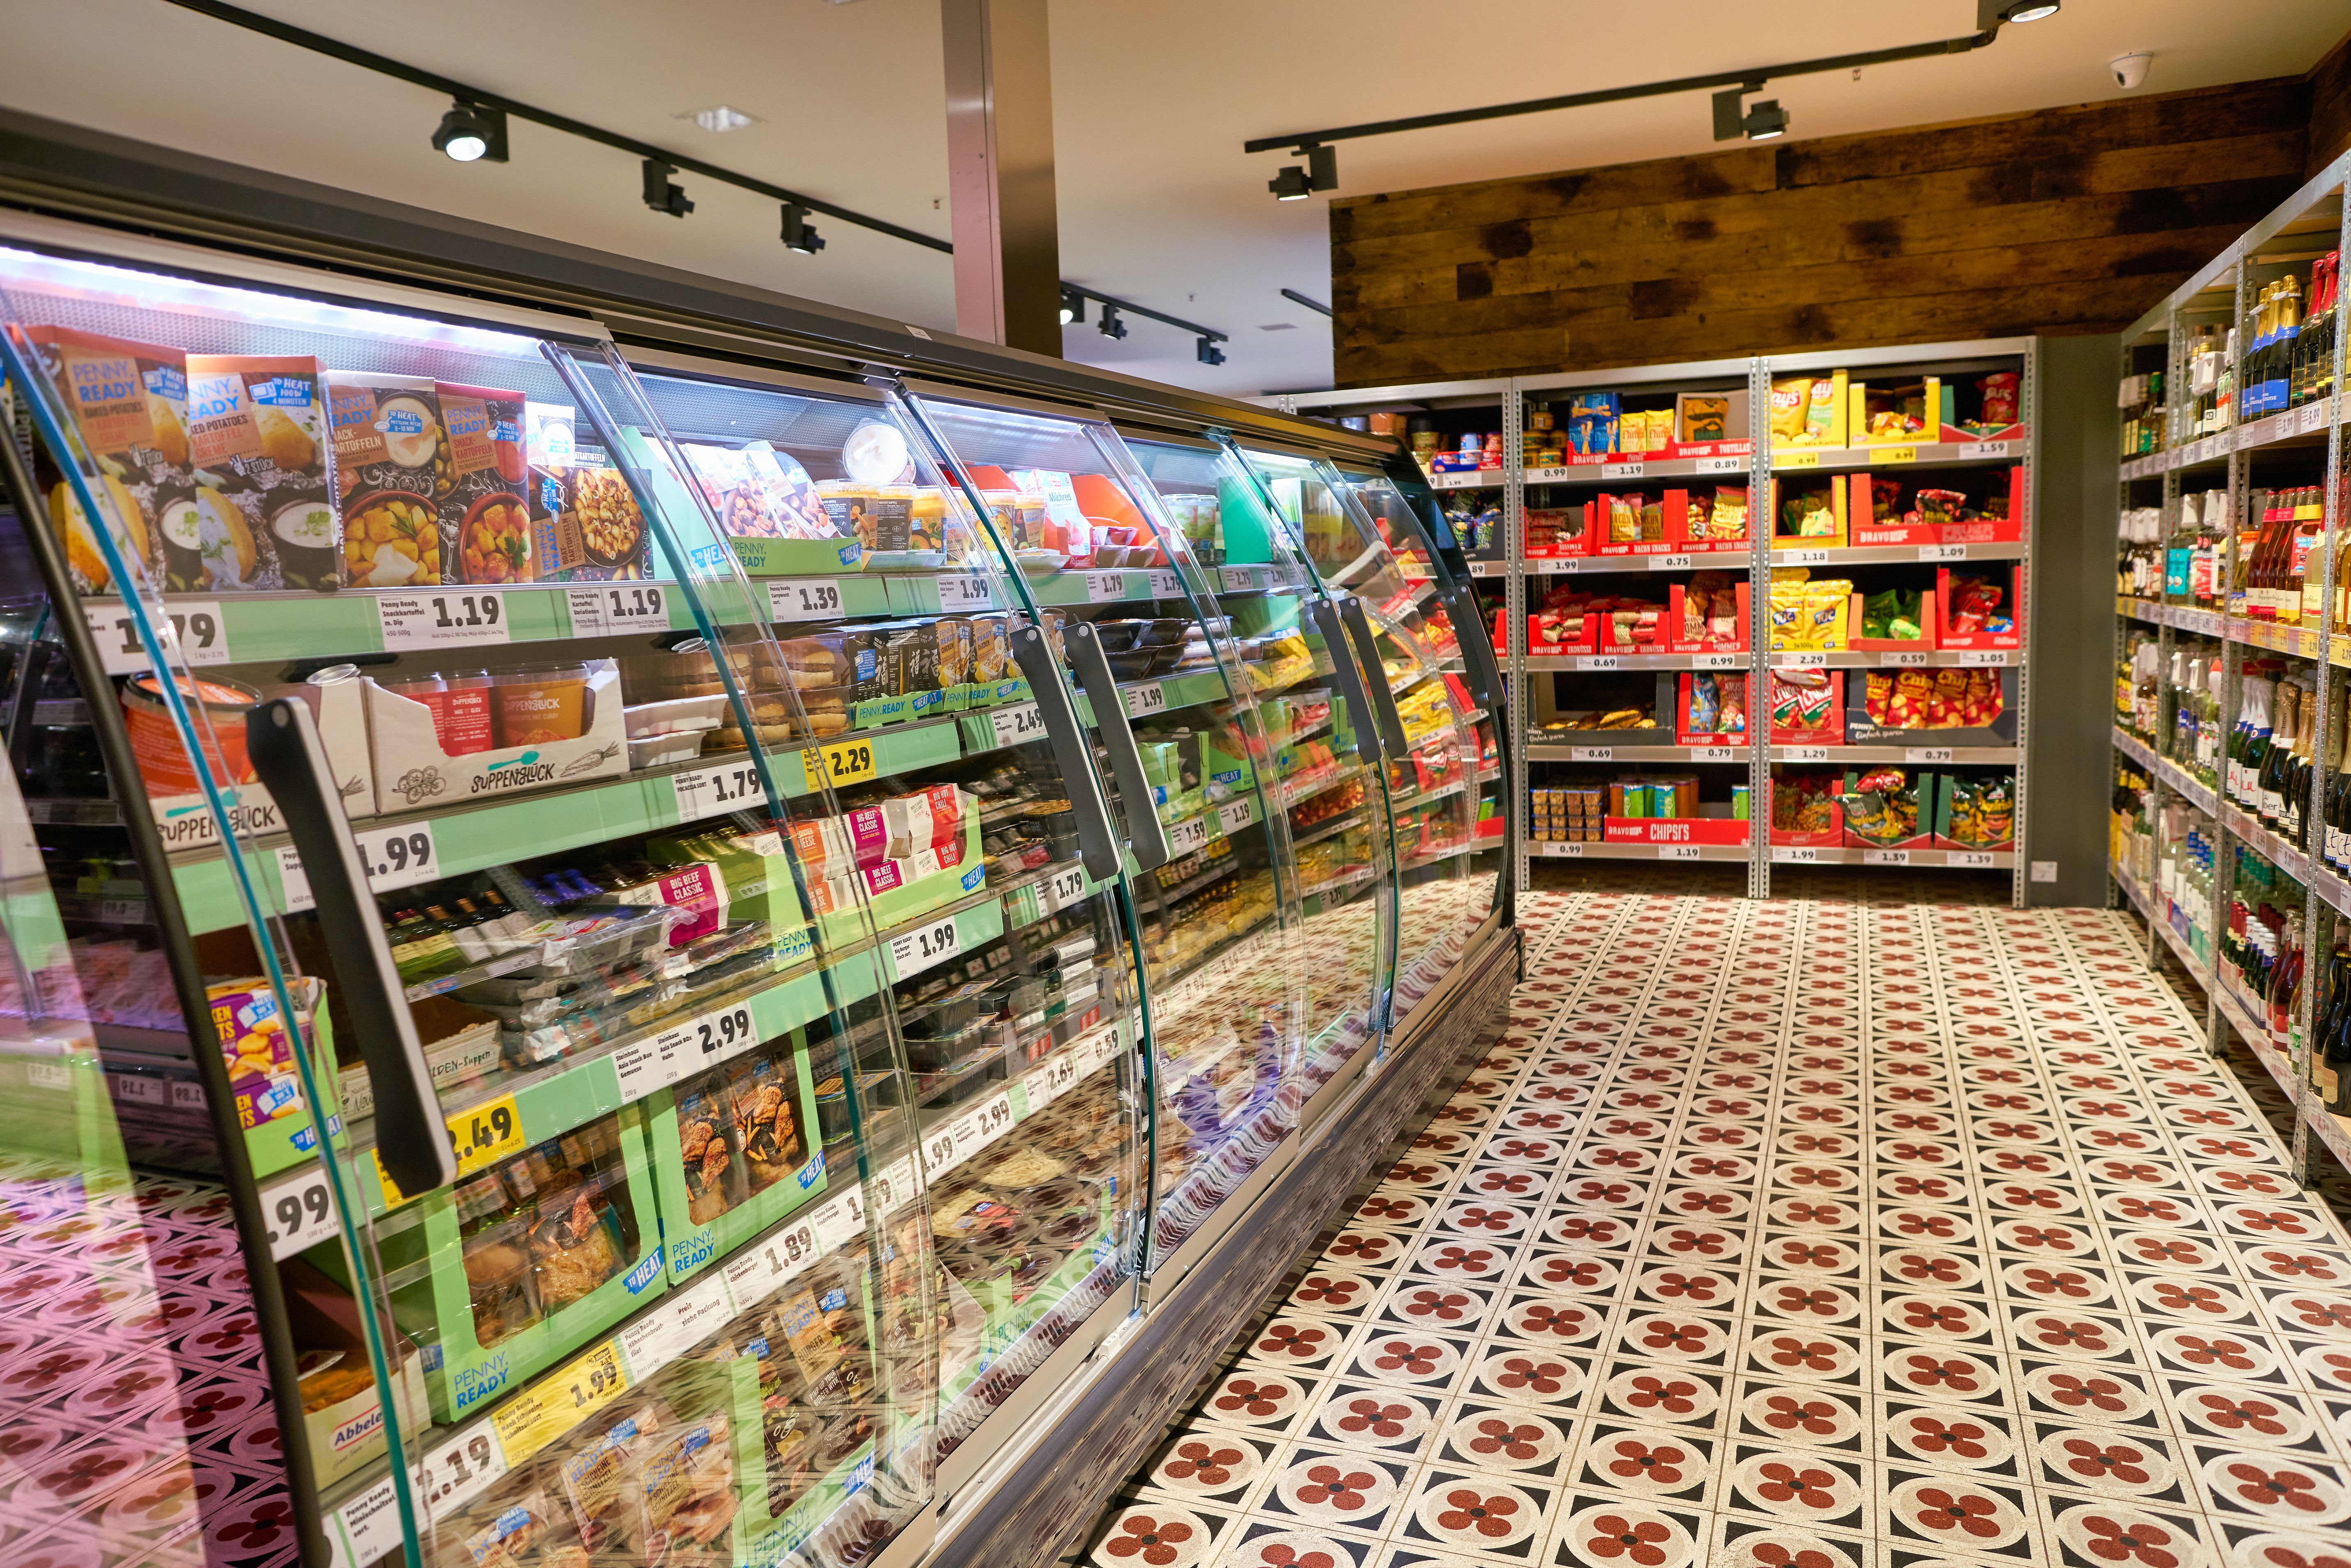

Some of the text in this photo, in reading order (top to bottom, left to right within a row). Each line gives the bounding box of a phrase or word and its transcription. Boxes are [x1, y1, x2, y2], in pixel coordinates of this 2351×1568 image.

[72, 360, 135, 382] PENNY.
[78, 381, 135, 403] READY
[283, 381, 311, 391] HEAT
[446, 405, 486, 422] PENNY.
[2309, 407, 2320, 425] 5.99
[450, 419, 486, 436] READY
[2283, 416, 2293, 432] 5.99
[453, 436, 476, 449] SNACK-
[1979, 443, 2004, 453] 1.59
[456, 444, 492, 459] KARTOFFELN
[1895, 451, 1914, 459] 0.99
[1715, 459, 1738, 469] 0.89
[1798, 456, 1816, 464] 0.99
[1544, 468, 1566, 478] 0.99
[1620, 465, 1642, 475] 1.19
[1049, 491, 1072, 502] Milchreis
[565, 517, 575, 563] KARTOFFELN
[1860, 530, 1889, 543] BRAVO
[560, 544, 569, 565] BRAT-
[735, 542, 767, 555] PENNY.
[845, 544, 860, 562] HEAT
[1802, 552, 1825, 561] 1.18
[1939, 547, 1964, 557] 1.09
[1555, 560, 1577, 570] 1.99
[1666, 557, 1689, 567] 0.75
[1235, 567, 1251, 586] 2.79
[1271, 566, 1285, 584] 2.79
[960, 579, 988, 599] 1.99
[1102, 575, 1122, 593] 1.79
[1163, 576, 1182, 592] 1.79
[609, 588, 661, 617] 1.19
[799, 587, 838, 611] 1.39
[432, 596, 499, 627] 1.19
[1532, 644, 1592, 654] BRAVO ERDNÜSSE
[1605, 644, 1665, 654] BRAVO ERDNÜSSE
[1674, 641, 1741, 652] BRAVO POMMES
[1593, 658, 1616, 667] 0.69
[1710, 657, 1733, 666] 0.99
[1800, 656, 1824, 664] 2.29
[1901, 654, 1925, 663] 0.59
[1979, 653, 2004, 662] 1.05
[1141, 688, 1162, 708] 1.99
[1015, 708, 1043, 733] 2.49
[1589, 749, 1610, 758] 0.69
[1708, 748, 1731, 757] 0.79
[1802, 750, 1825, 758] 1.29
[1925, 751, 1950, 760] 0.79
[831, 746, 870, 776] 2.29
[689, 774, 703, 782] READY
[713, 768, 761, 802] 1.79
[940, 789, 948, 798] HOT
[935, 799, 947, 809] CHILI
[856, 810, 875, 823] BIG BEEF
[1232, 803, 1250, 823] 1.19
[859, 820, 878, 833] CLASSIC
[1186, 821, 1205, 844] 1.59
[1608, 824, 1690, 841] BRAVO CHIPSI'S
[948, 843, 957, 853] HOT
[1560, 845, 1581, 854] 0.99
[1676, 848, 1698, 857] 1.19
[1791, 850, 1814, 860] 1.99
[943, 854, 956, 864] CHILI
[1882, 852, 1906, 861] 1.39
[1966, 854, 1991, 863] 1.39
[2284, 851, 2294, 869] 3.89
[670, 871, 700, 890] BIG BEEF
[875, 874, 895, 888] CLASSIC
[963, 865, 983, 886] TO HEAT
[673, 882, 703, 901] CLASSIC
[1056, 871, 1083, 900] 1.79
[1329, 886, 1343, 902] 2.79
[900, 944, 910, 952] Burger
[902, 936, 912, 944] READY
[919, 924, 954, 958] 1.99
[657, 1032, 679, 1045] Steinhaus
[698, 1009, 749, 1054] 2.99
[1094, 1029, 1119, 1060] 0.59
[616, 1049, 639, 1061] Steinhaus
[661, 1052, 674, 1061] Huhn
[620, 1066, 642, 1078] Gemuese
[1047, 1058, 1074, 1091] 2.69
[978, 1099, 1010, 1136] 2.99
[814, 1203, 837, 1220] Penny Ready
[816, 1210, 840, 1227] Rinderburger
[673, 1228, 714, 1258] PENNY.
[765, 1226, 813, 1276] 1.89
[674, 1243, 715, 1273] READY
[628, 1249, 662, 1287] TO HEAT
[677, 1302, 693, 1315] Preis
[682, 1297, 721, 1327] siehe Packung
[631, 1347, 642, 1357] filet
[454, 1351, 509, 1392] PENNY.
[457, 1368, 509, 1409] READY
[570, 1361, 618, 1408] 1.99
[809, 1369, 836, 1401] PIMP UP YOUR
[813, 1378, 839, 1406] BURGER WITH
[571, 1448, 604, 1484] READY
[847, 1450, 875, 1489] TO HEA
[646, 1457, 676, 1495] READY
[581, 1469, 615, 1503] SCHNITZEL
[346, 1486, 390, 1518] Penny Ready
[349, 1494, 396, 1528] Minischnitzel
[353, 1526, 370, 1538] sort.
[753, 1501, 811, 1556] PENNY.
